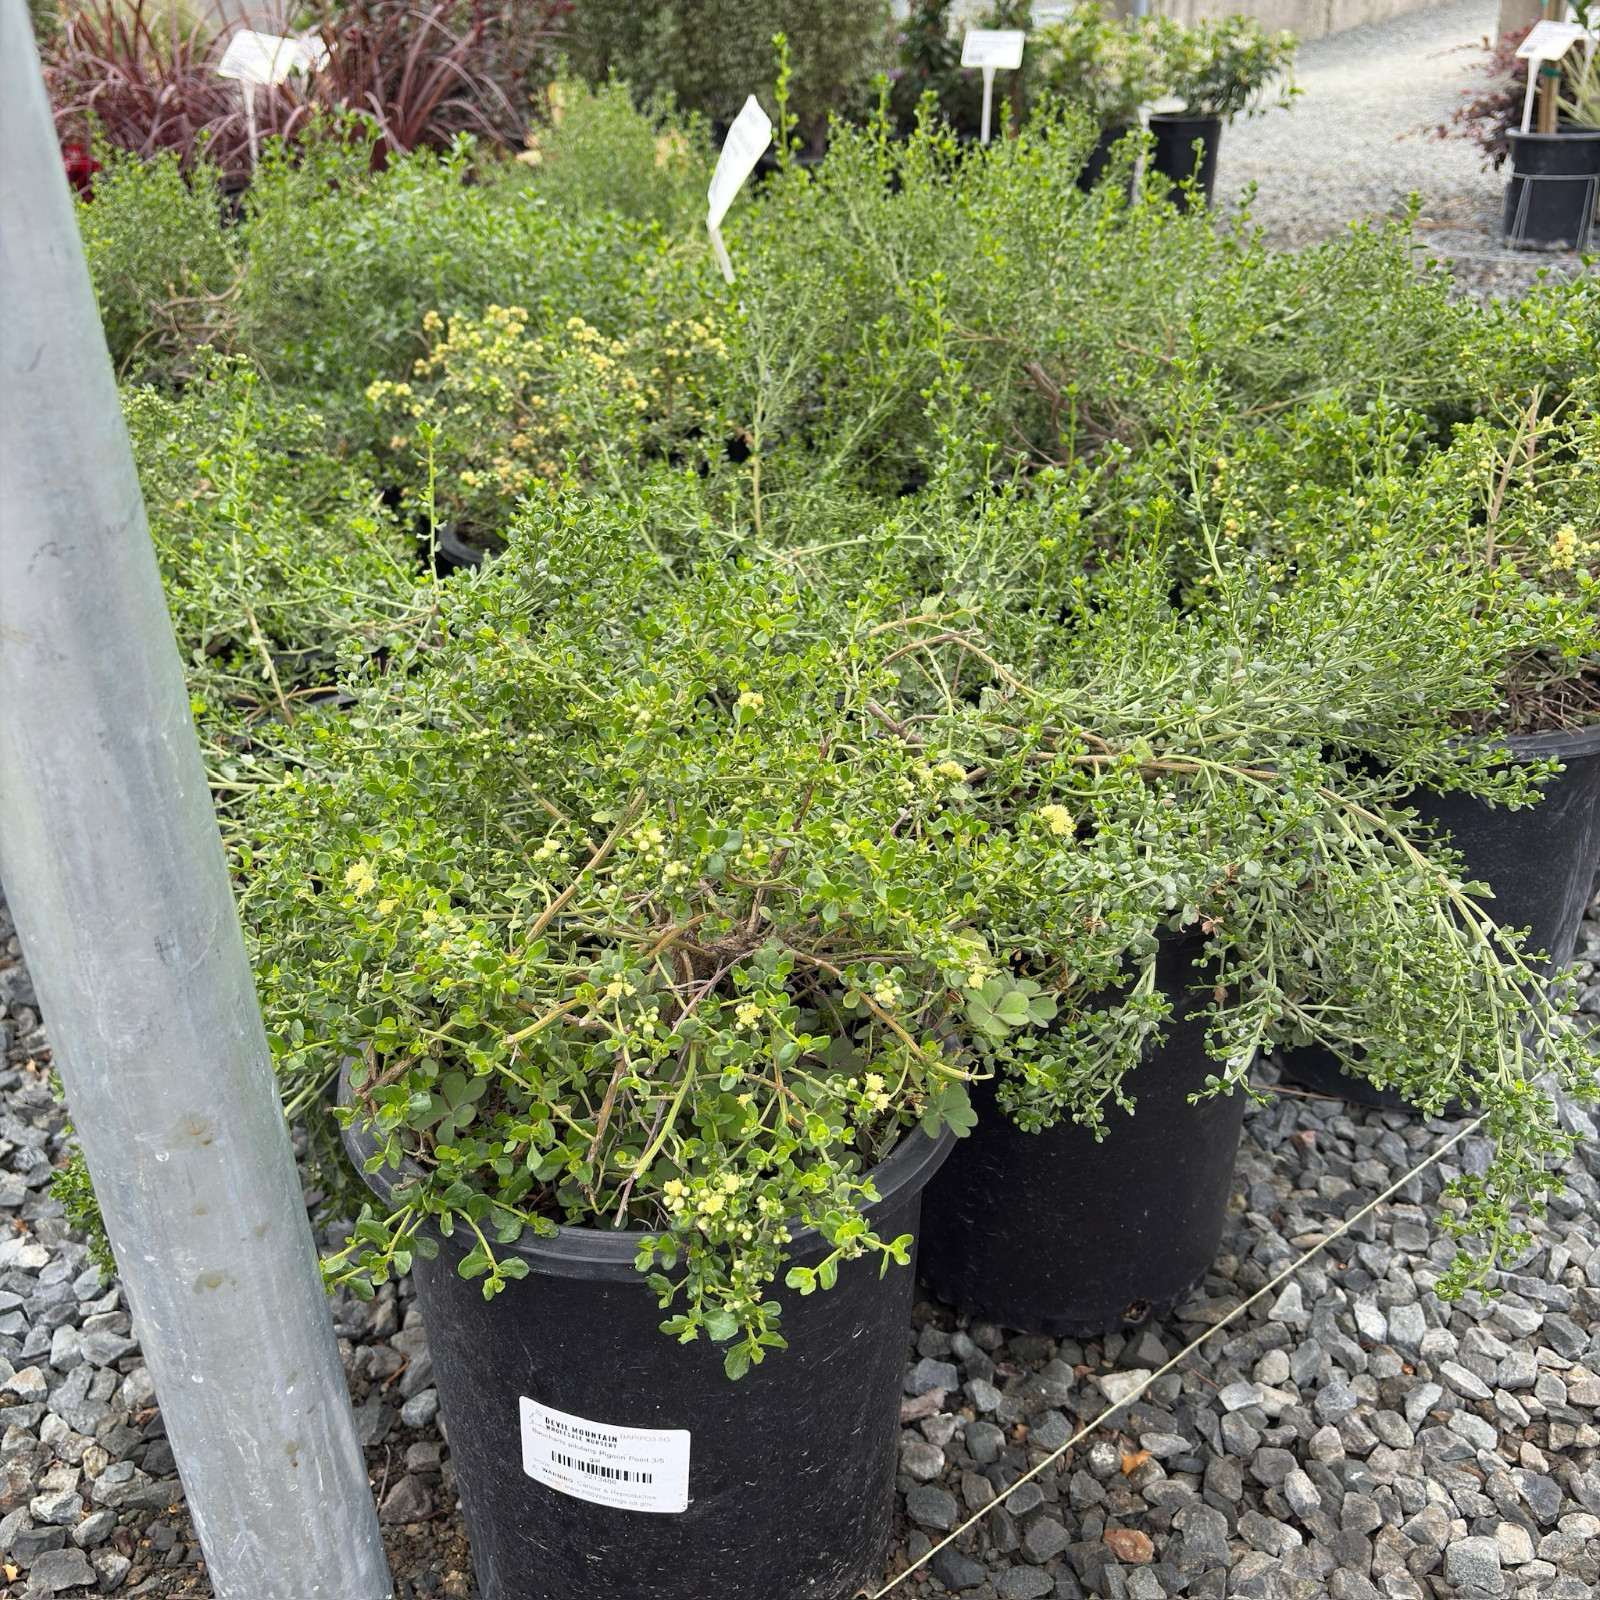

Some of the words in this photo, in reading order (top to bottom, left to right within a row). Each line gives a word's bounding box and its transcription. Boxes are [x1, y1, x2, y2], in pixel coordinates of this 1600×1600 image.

[545, 1416, 568, 1431] DEVIL
[572, 1426, 618, 1443] MOUNTAIN
[545, 1425, 582, 1442] WHOLESALE
[586, 1438, 617, 1449] NURSERY
[600, 1449, 626, 1461] Pigeon
[629, 1455, 649, 1463] Point
